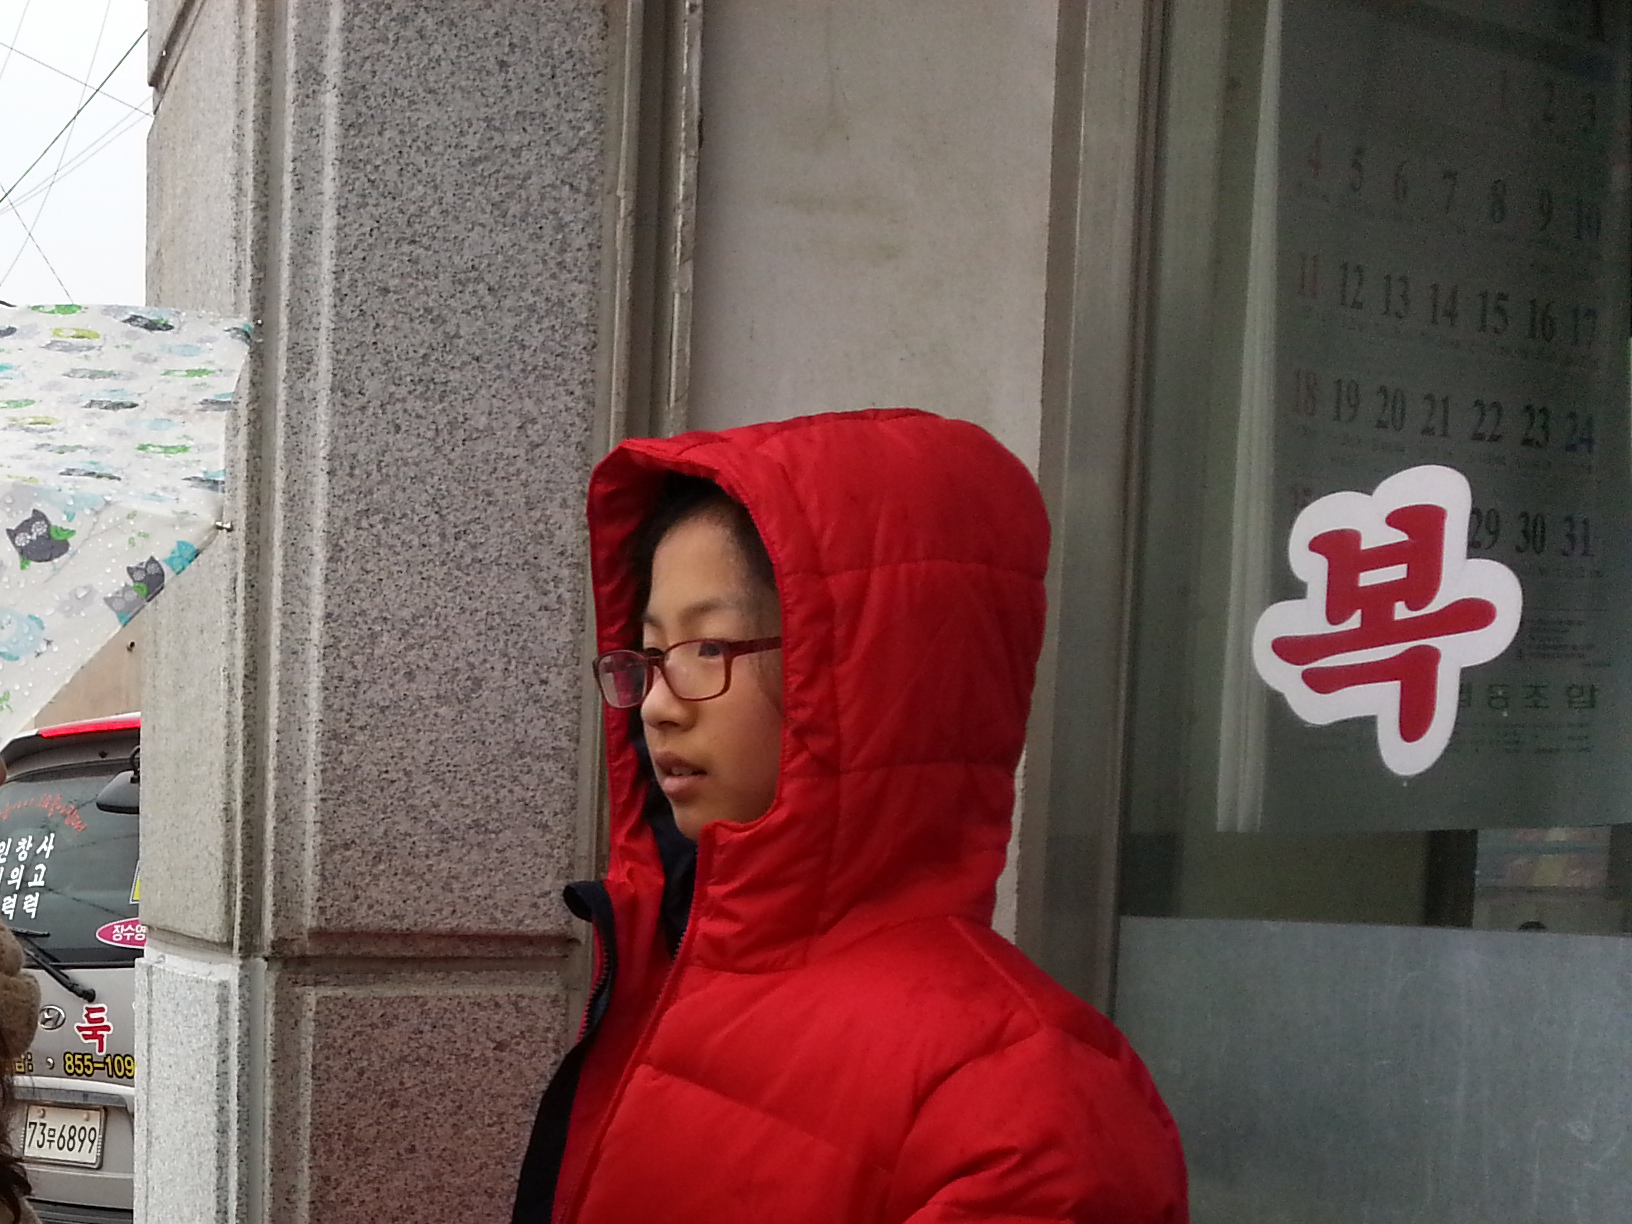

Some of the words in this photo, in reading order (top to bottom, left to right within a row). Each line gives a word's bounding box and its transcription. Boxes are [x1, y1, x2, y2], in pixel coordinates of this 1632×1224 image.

[1349, 145, 1367, 195] 5
[1393, 158, 1410, 205] 6
[1440, 168, 1459, 215] 7
[1489, 178, 1508, 225] 8
[1537, 187, 1554, 233] 9
[1295, 251, 1320, 301] 11
[1337, 260, 1366, 310] 12
[1380, 271, 1412, 321] 13
[1428, 281, 1460, 329] 14
[1476, 288, 1511, 335] 15
[1526, 297, 1559, 344] 16
[1570, 303, 1599, 350] 17
[1291, 367, 1320, 418] 18
[1331, 377, 1363, 425] 19
[1373, 383, 1409, 434] 20
[1419, 391, 1453, 440] 21
[1469, 397, 1505, 444] 22
[1519, 403, 1552, 450] 23
[1563, 409, 1597, 456] 24
[1467, 506, 1502, 552] 29
[1514, 509, 1548, 556] 30
[1559, 512, 1595, 559] 31
[1270, 503, 1497, 744] 복
[75, 1005, 113, 1053] 둑
[27, 1120, 98, 1155] 73무6899
